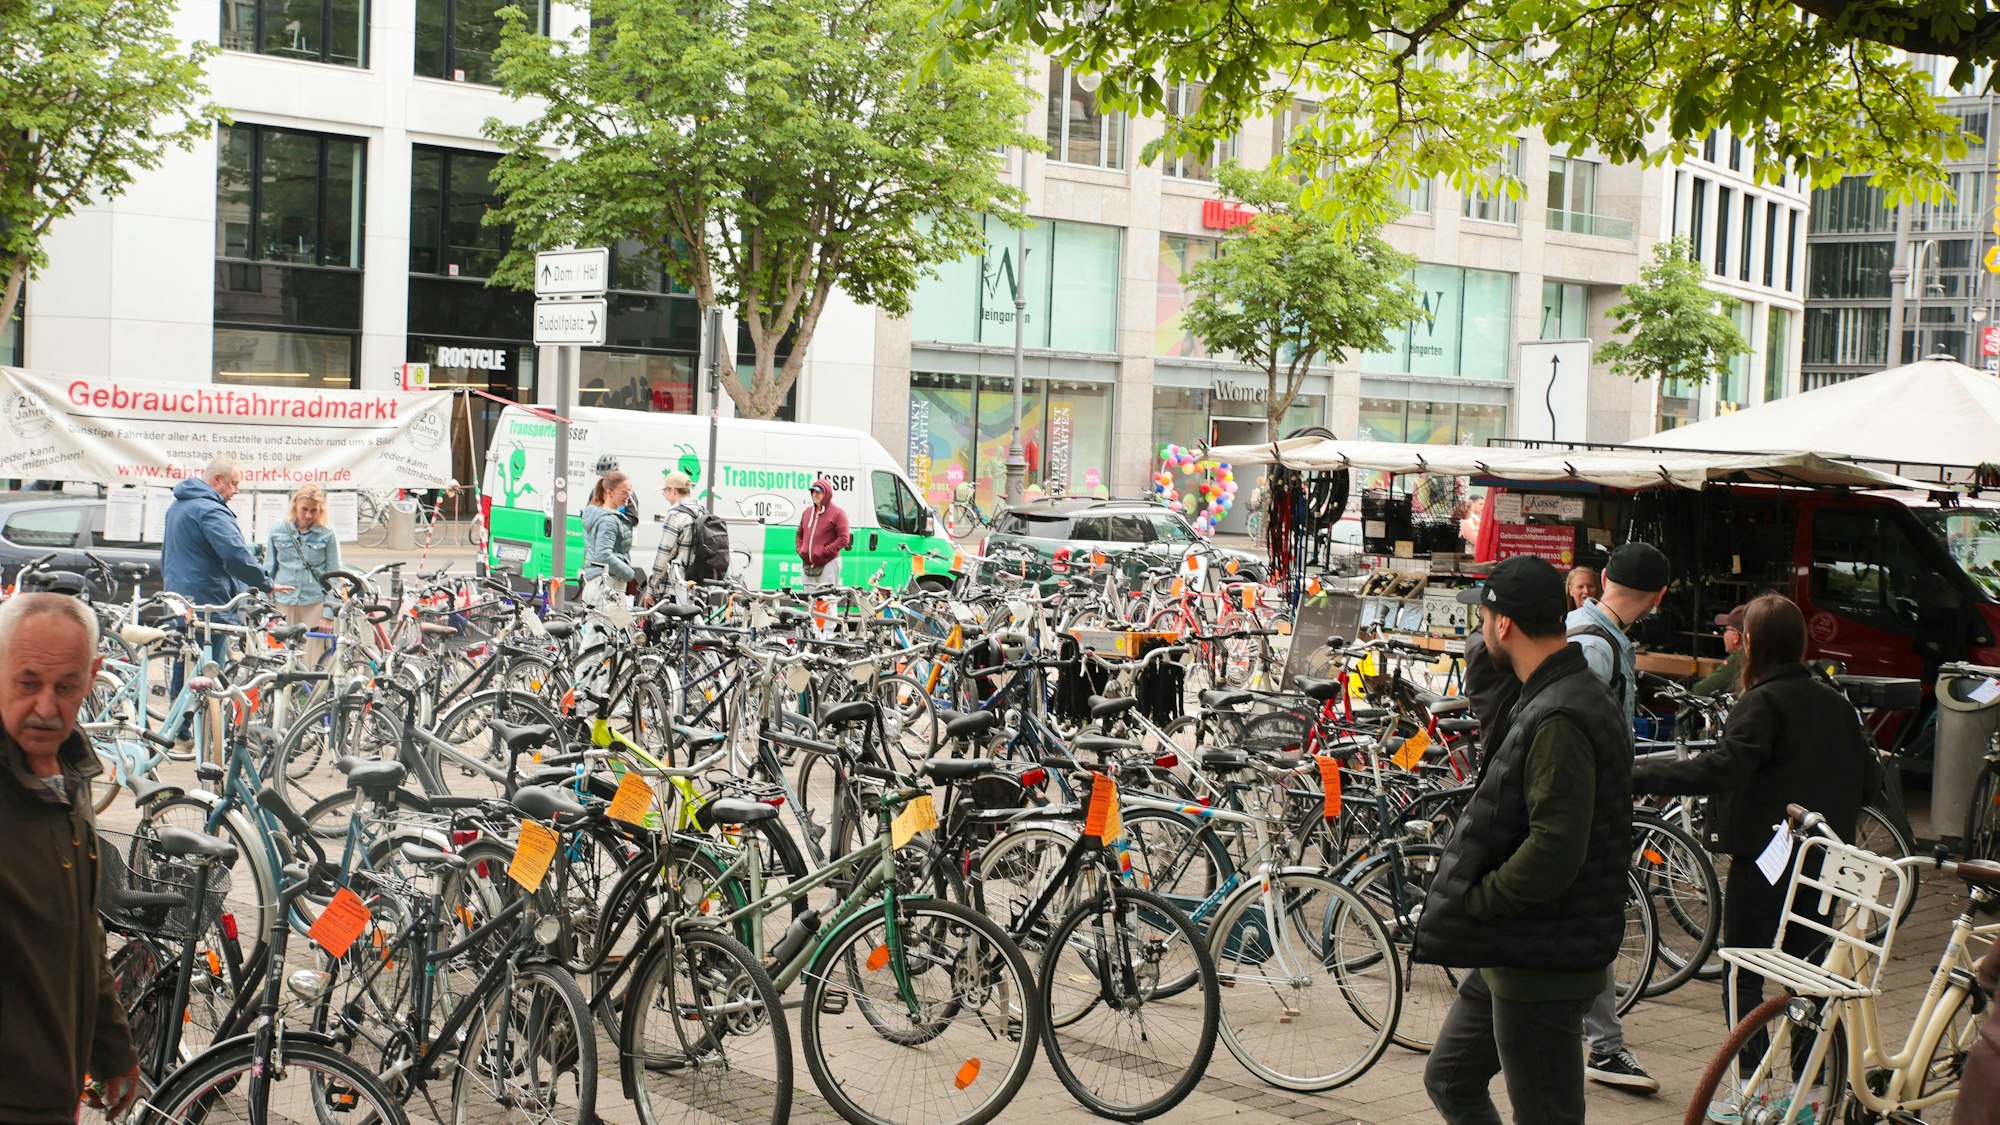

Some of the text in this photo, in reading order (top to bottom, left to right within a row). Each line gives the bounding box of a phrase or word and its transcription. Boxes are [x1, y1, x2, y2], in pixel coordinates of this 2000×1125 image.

[554, 266, 573, 281] Dom
[583, 264, 598, 280] Hbf
[539, 315, 584, 334] Rudolfplatz
[981, 307, 1031, 324] eingarn
[437, 346, 506, 371] ROCYCLE
[1402, 342, 1443, 357] eingarten
[18, 395, 37, 407] 20
[67, 381, 398, 420] Gebrauchtfahrradmarkt
[15, 407, 46, 420] Jahre
[420, 413, 436, 425] 20
[68, 424, 114, 439] Günstige
[118, 428, 164, 441] Fahrräder
[168, 433, 190, 442] aller
[212, 434, 261, 445] Ersatzteile
[265, 435, 283, 445] und
[285, 436, 324, 447] Zubehör
[326, 437, 346, 446] rund
[413, 422, 439, 436] Jahre
[509, 420, 588, 441] Transporte sser
[0, 446, 55, 467] jeder kann
[22, 450, 84, 470] mitmachen!
[167, 450, 213, 460] samstags
[240, 451, 254, 460] bis
[258, 452, 283, 461] 16:00
[286, 453, 302, 462] Uhr
[379, 448, 428, 470] jeder kann
[117, 463, 351, 482] www.fahrrarkt-koeln.de
[396, 465, 446, 485] mitmachen!
[723, 466, 812, 490] Transporter
[1527, 495, 1559, 512] Kasse
[1500, 532, 1573, 542] Gebrauchtfahrradmärkte
